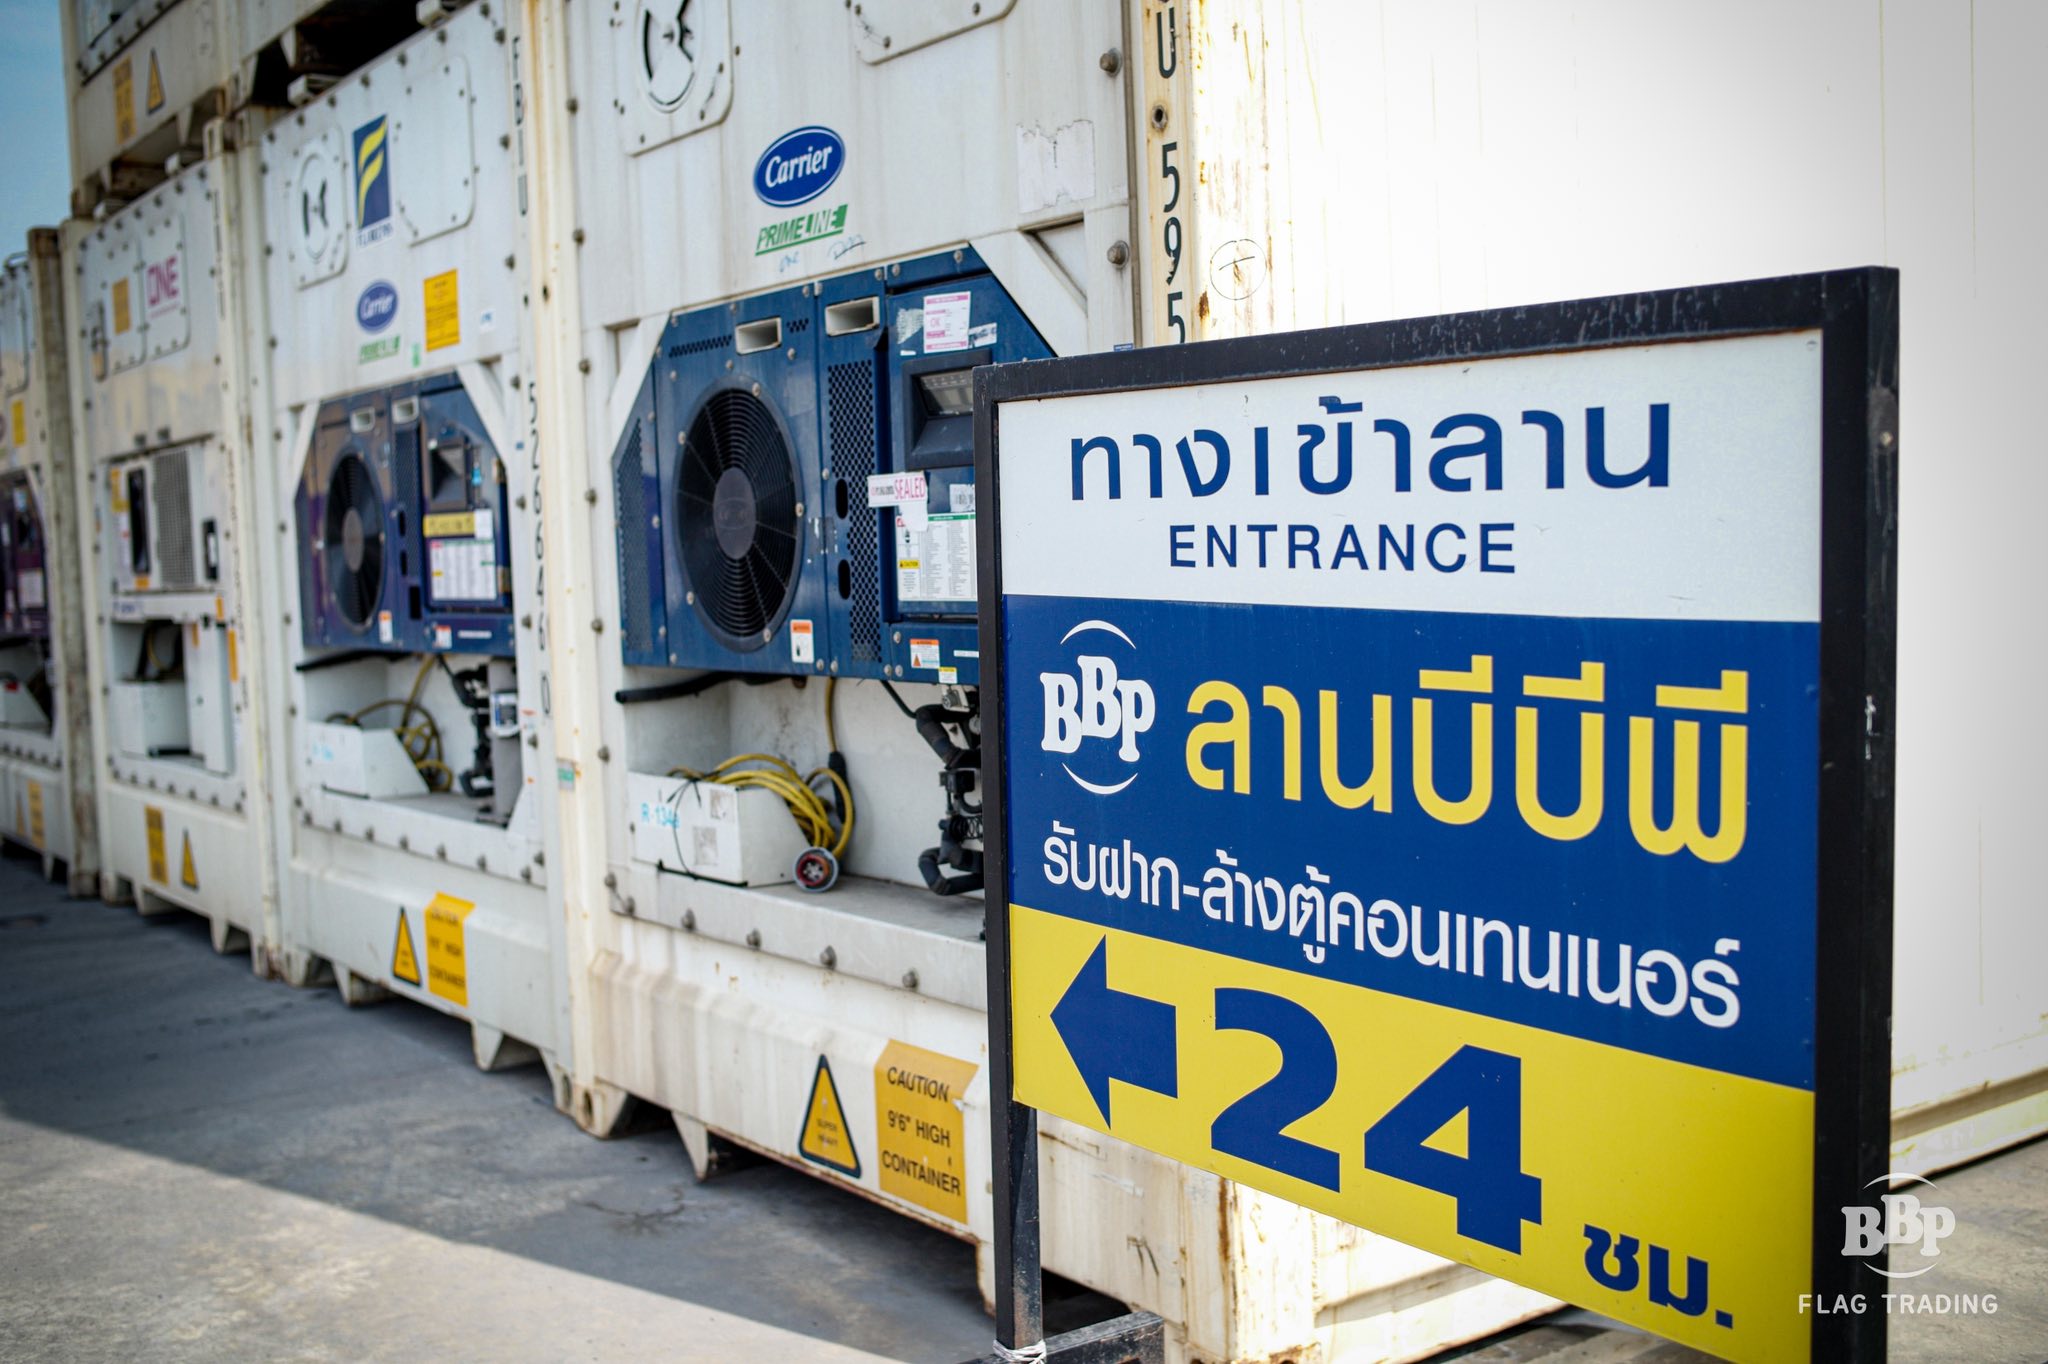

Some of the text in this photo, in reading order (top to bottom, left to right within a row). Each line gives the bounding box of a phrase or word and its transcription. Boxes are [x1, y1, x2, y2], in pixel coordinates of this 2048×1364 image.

[1156, 0, 1177, 79] U
[764, 145, 833, 188] Carrier
[1071, 395, 1671, 501] ทางเข้าลาน
[893, 477, 926, 500] SEALED
[1169, 522, 1517, 574] ENTRANCE
[1038, 655, 1156, 764] BBP
[1184, 653, 1749, 864] ลานบีบีพี
[886, 1066, 951, 1103] CAUTION
[916, 1119, 951, 1148] HIGH
[1211, 987, 1734, 1329] 24 ชม.
[881, 1149, 962, 1197] CONTAINER
